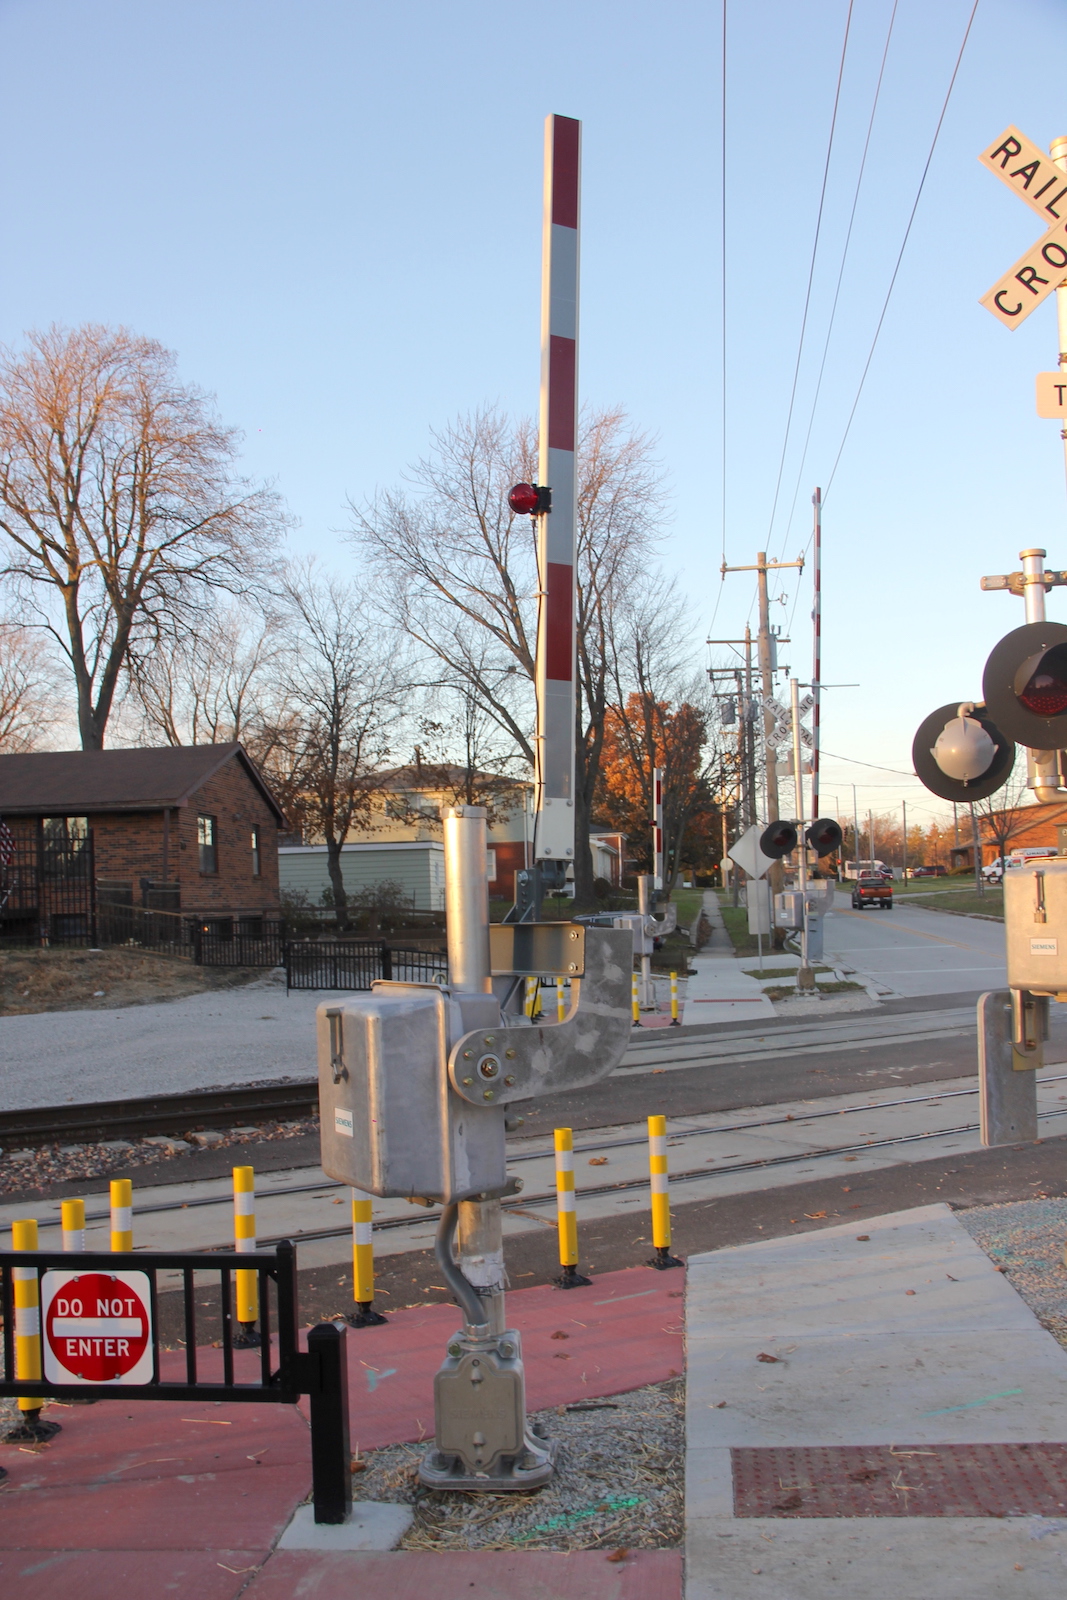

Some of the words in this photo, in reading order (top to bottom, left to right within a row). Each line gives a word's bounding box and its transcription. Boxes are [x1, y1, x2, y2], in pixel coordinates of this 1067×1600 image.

[994, 224, 1067, 317] CRO
[57, 1298, 83, 1316] DO
[96, 1298, 135, 1316] NOT
[66, 1338, 130, 1357] ENTER
